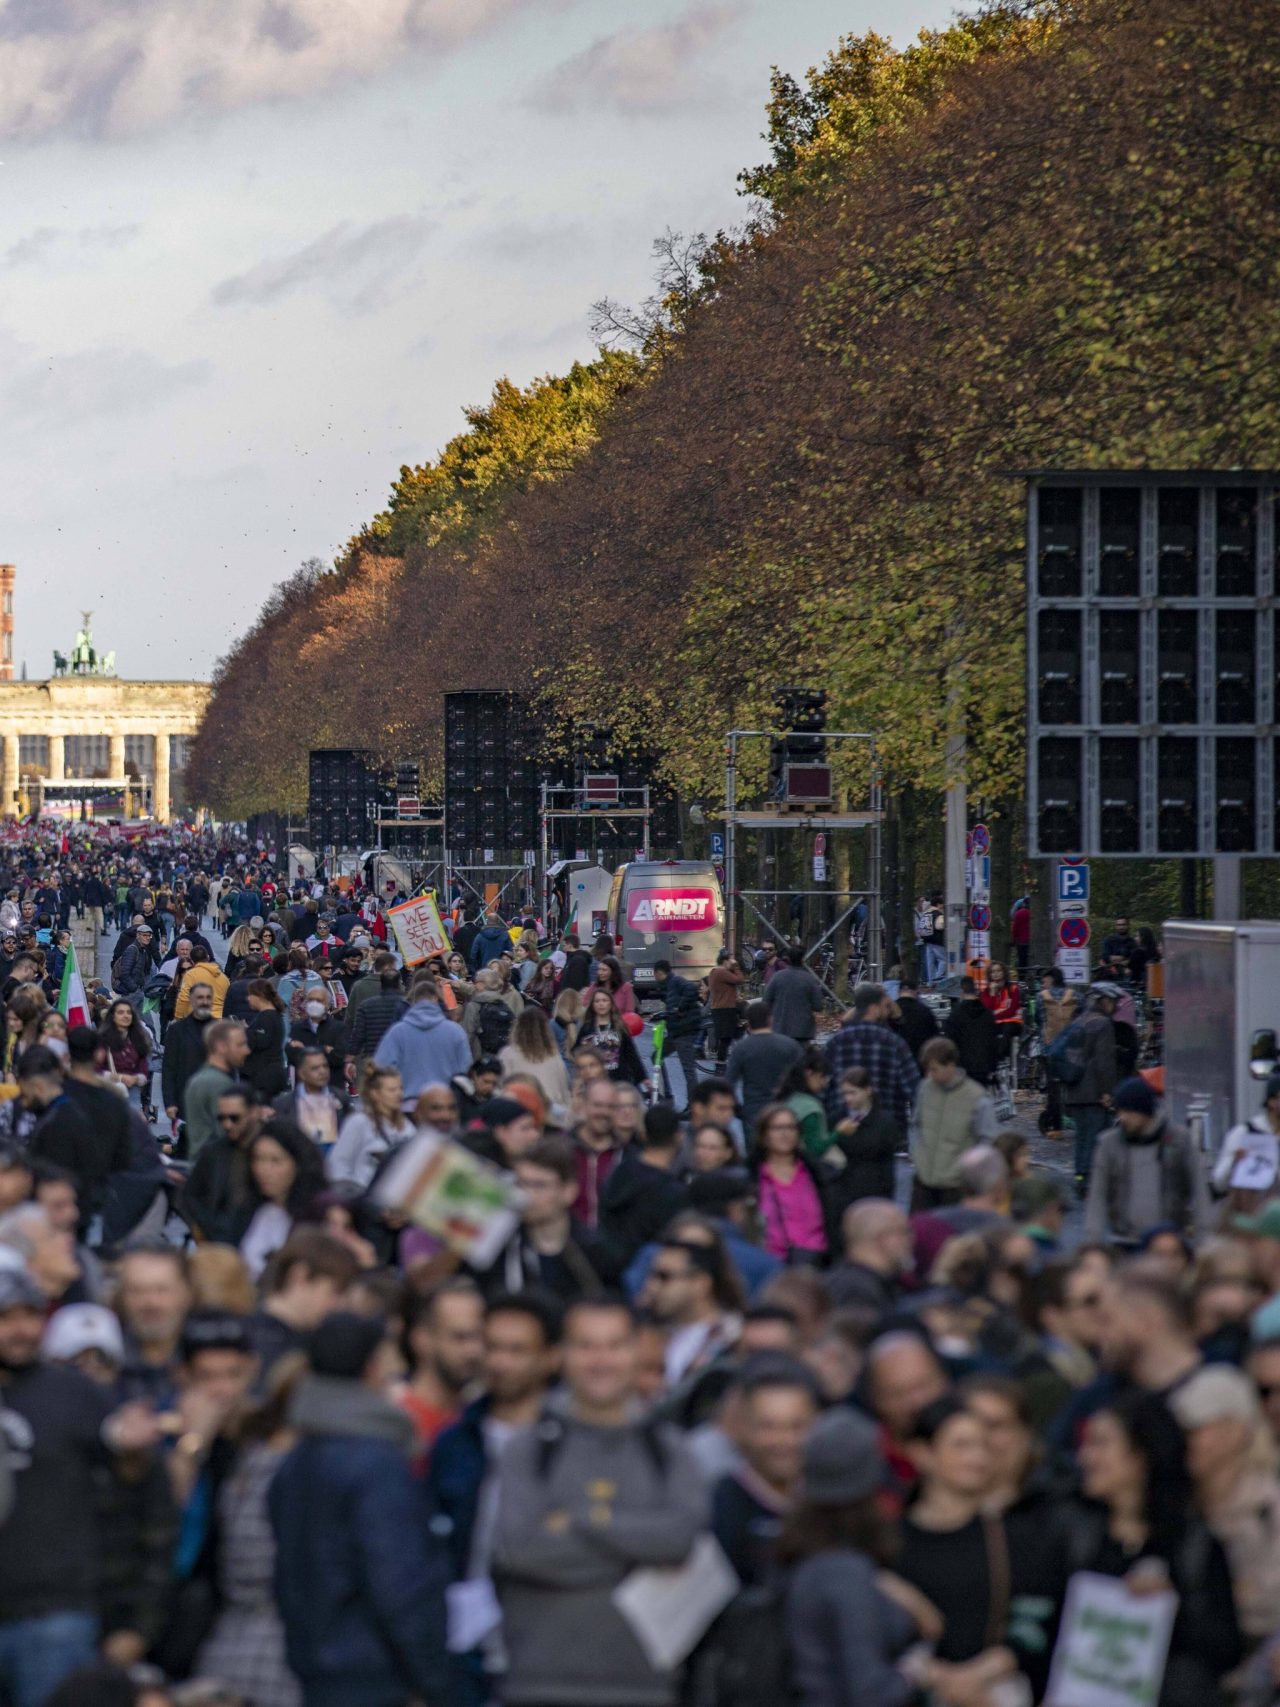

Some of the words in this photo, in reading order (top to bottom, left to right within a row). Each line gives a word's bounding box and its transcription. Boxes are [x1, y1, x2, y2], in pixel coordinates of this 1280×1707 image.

[1063, 870, 1080, 896] P
[402, 905, 430, 925] WE
[633, 898, 709, 920] ARNDT
[406, 922, 431, 939] SEE
[412, 933, 445, 955] YOU
